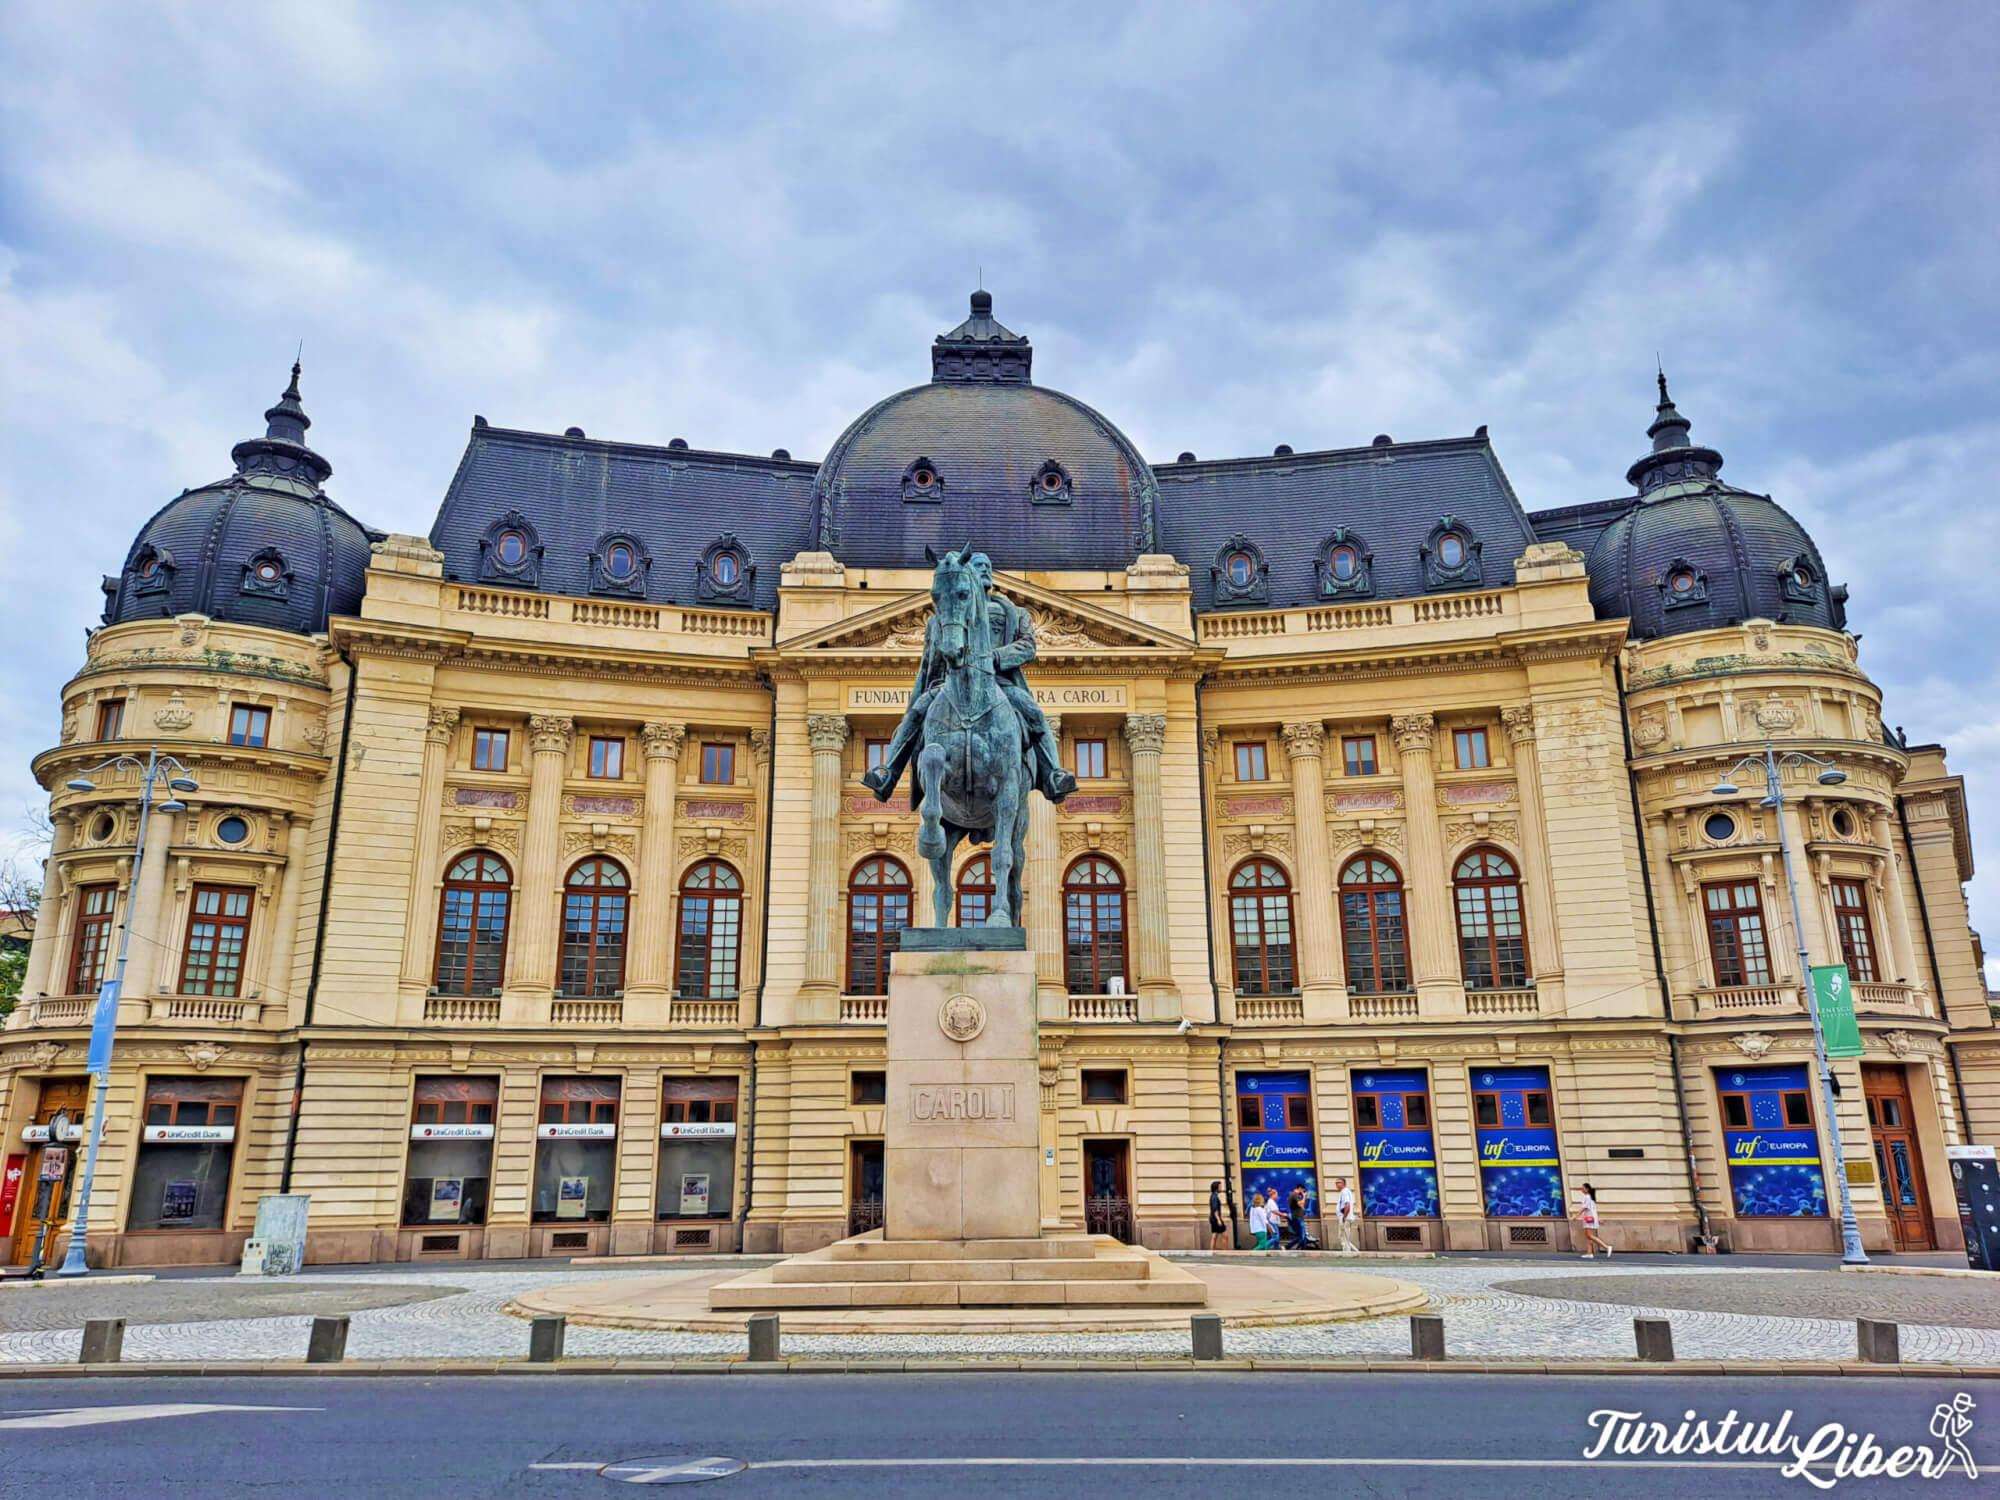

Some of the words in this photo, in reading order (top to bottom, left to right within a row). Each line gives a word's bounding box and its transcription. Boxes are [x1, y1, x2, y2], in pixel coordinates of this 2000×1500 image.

[1063, 690, 1109, 703] CAROL
[1115, 690, 1121, 703] I
[914, 1087, 997, 1120] CAROL
[168, 1130, 201, 1138] UniCredit
[433, 1128, 464, 1136] UniCredit
[465, 1128, 482, 1136] Bank
[680, 1126, 709, 1134] UniCredit
[709, 1126, 724, 1134] Bank
[1394, 1146, 1428, 1154] EUROPA
[1769, 1142, 1808, 1150] EUROPA
